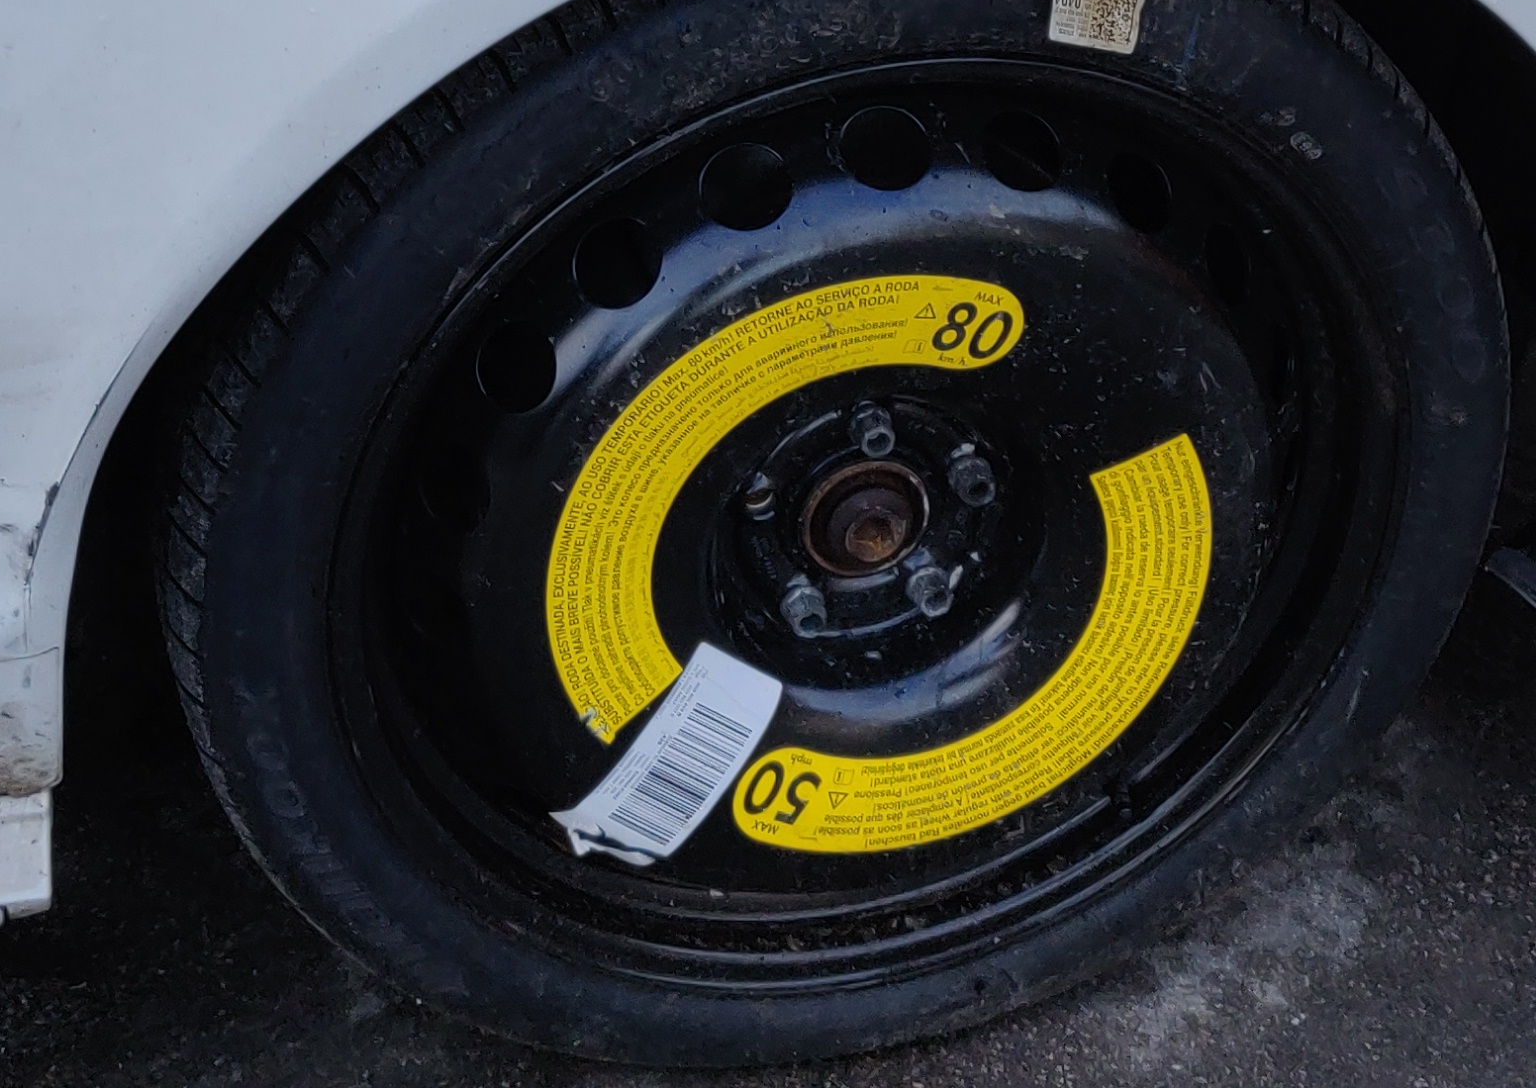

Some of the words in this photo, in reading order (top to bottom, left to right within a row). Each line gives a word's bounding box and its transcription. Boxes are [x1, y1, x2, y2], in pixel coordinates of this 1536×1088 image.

[815, 284, 869, 307] SERVIÇO
[872, 283, 881, 293] A
[885, 281, 920, 292] RODA
[974, 291, 1003, 306] MAX
[793, 297, 813, 311] AO
[836, 299, 855, 312] DA
[858, 294, 899, 308] RODA!
[733, 304, 793, 337] RETORNE
[756, 304, 833, 340] UTILIZAÇÃO
[933, 301, 1012, 359] 80
[699, 331, 735, 358] km/h!
[744, 334, 757, 346] A
[686, 353, 704, 368] 80
[687, 340, 746, 382] DURANTE
[937, 354, 967, 367] km/h
[637, 379, 690, 428] ETIQUETA
[598, 383, 665, 454] TEMPORÁRIO!
[615, 427, 643, 456] ESTA
[617, 472, 642, 508] колесо
[695, 377, 733, 407] только
[730, 363, 755, 382] для
[585, 455, 608, 479] USO
[590, 456, 622, 500] COBRIR
[576, 480, 594, 497] AO
[578, 501, 598, 526] NÃO
[552, 498, 586, 598] EXCLUSIVAMENTE,
[566, 529, 588, 587] POSSÍVEL!
[567, 589, 579, 626] BREVE
[569, 626, 585, 654] MAIS
[575, 654, 589, 665] O
[563, 660, 583, 690] RODA
[578, 662, 623, 728] SUBSTITUÍDA
[1124, 684, 1137, 696] to
[1109, 694, 1129, 713] tyre
[790, 753, 813, 765] mph
[1011, 763, 1053, 792] Replace
[744, 763, 822, 826] 50
[752, 821, 779, 835] MAX
[877, 823, 902, 834] soon
[918, 826, 940, 839] Rad
